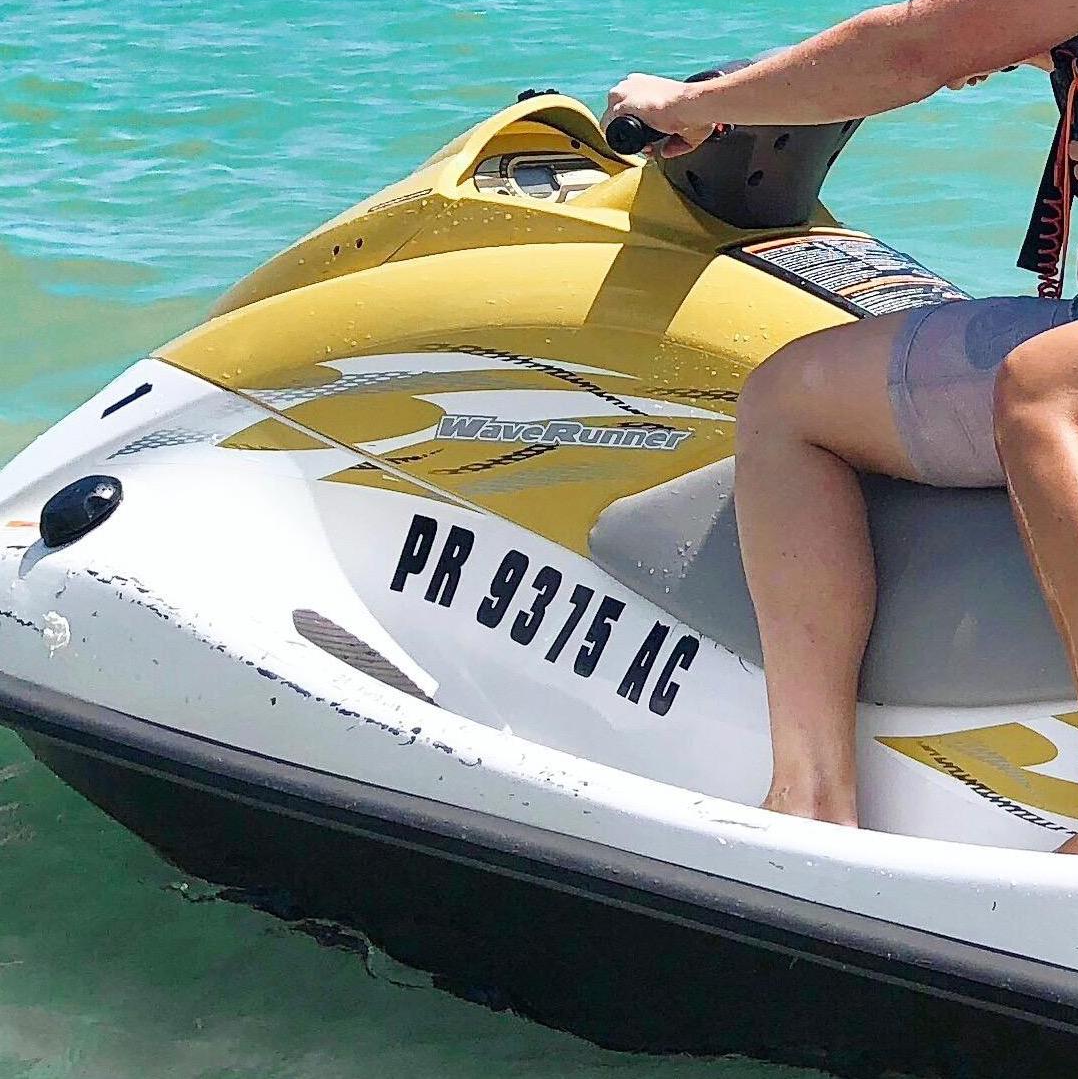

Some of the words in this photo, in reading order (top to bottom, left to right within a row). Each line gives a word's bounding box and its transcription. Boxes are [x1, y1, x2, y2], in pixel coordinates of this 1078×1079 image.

[437, 415, 692, 450] WaveRunner
[389, 513, 475, 608] PR
[476, 549, 627, 678] 9375
[616, 620, 700, 717] AC
